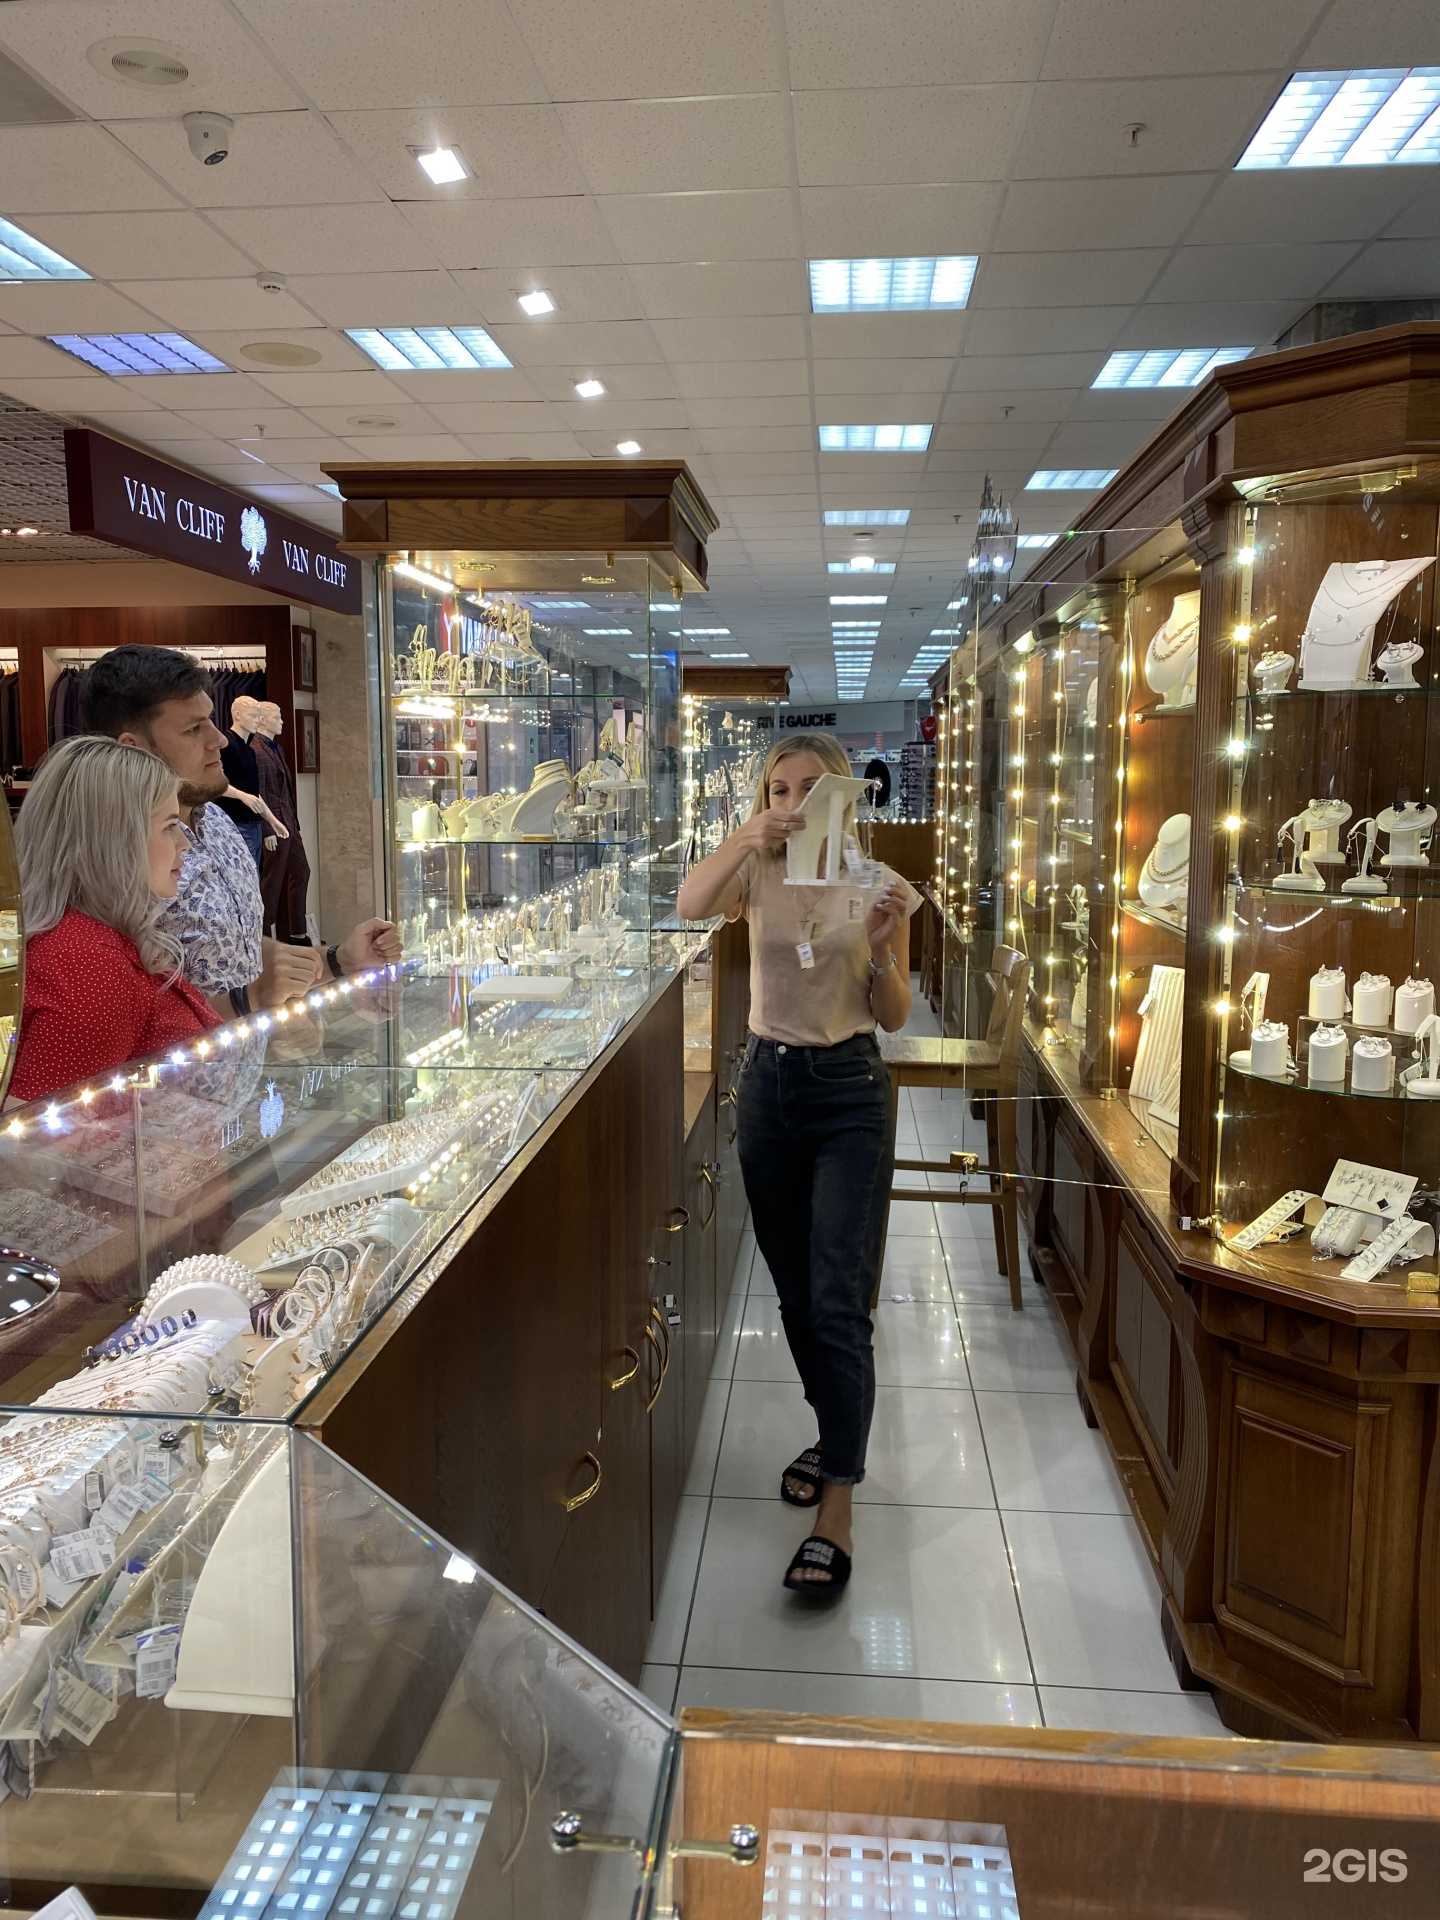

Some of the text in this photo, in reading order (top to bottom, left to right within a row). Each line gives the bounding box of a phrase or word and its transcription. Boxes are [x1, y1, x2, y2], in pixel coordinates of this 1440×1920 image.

[124, 475, 225, 543] VAN CLIFF
[282, 540, 347, 588] VAN CLIFF
[786, 713, 837, 728] GAUCHE
